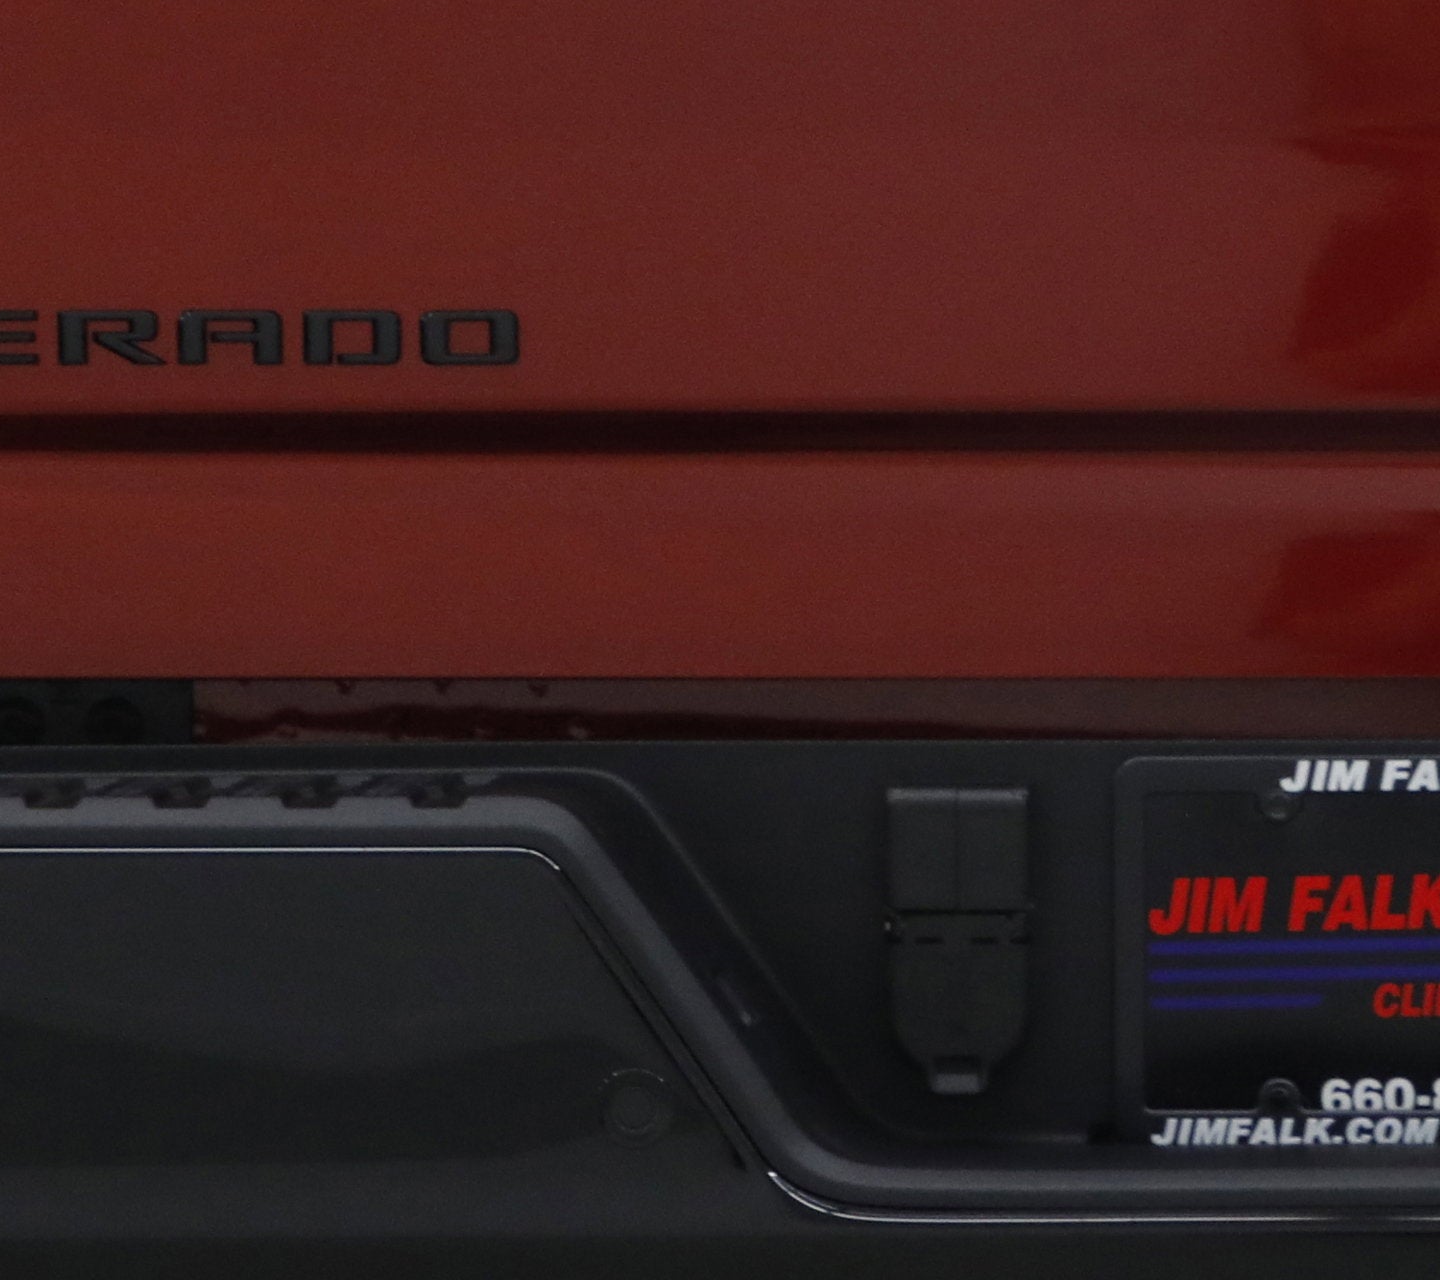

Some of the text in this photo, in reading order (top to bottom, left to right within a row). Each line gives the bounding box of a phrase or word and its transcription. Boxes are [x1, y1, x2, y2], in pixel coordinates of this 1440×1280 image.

[1279, 760, 1370, 793] JIM
[1148, 876, 1268, 936] JIM
[1150, 1117, 1440, 1146] JIMFALK.COM
